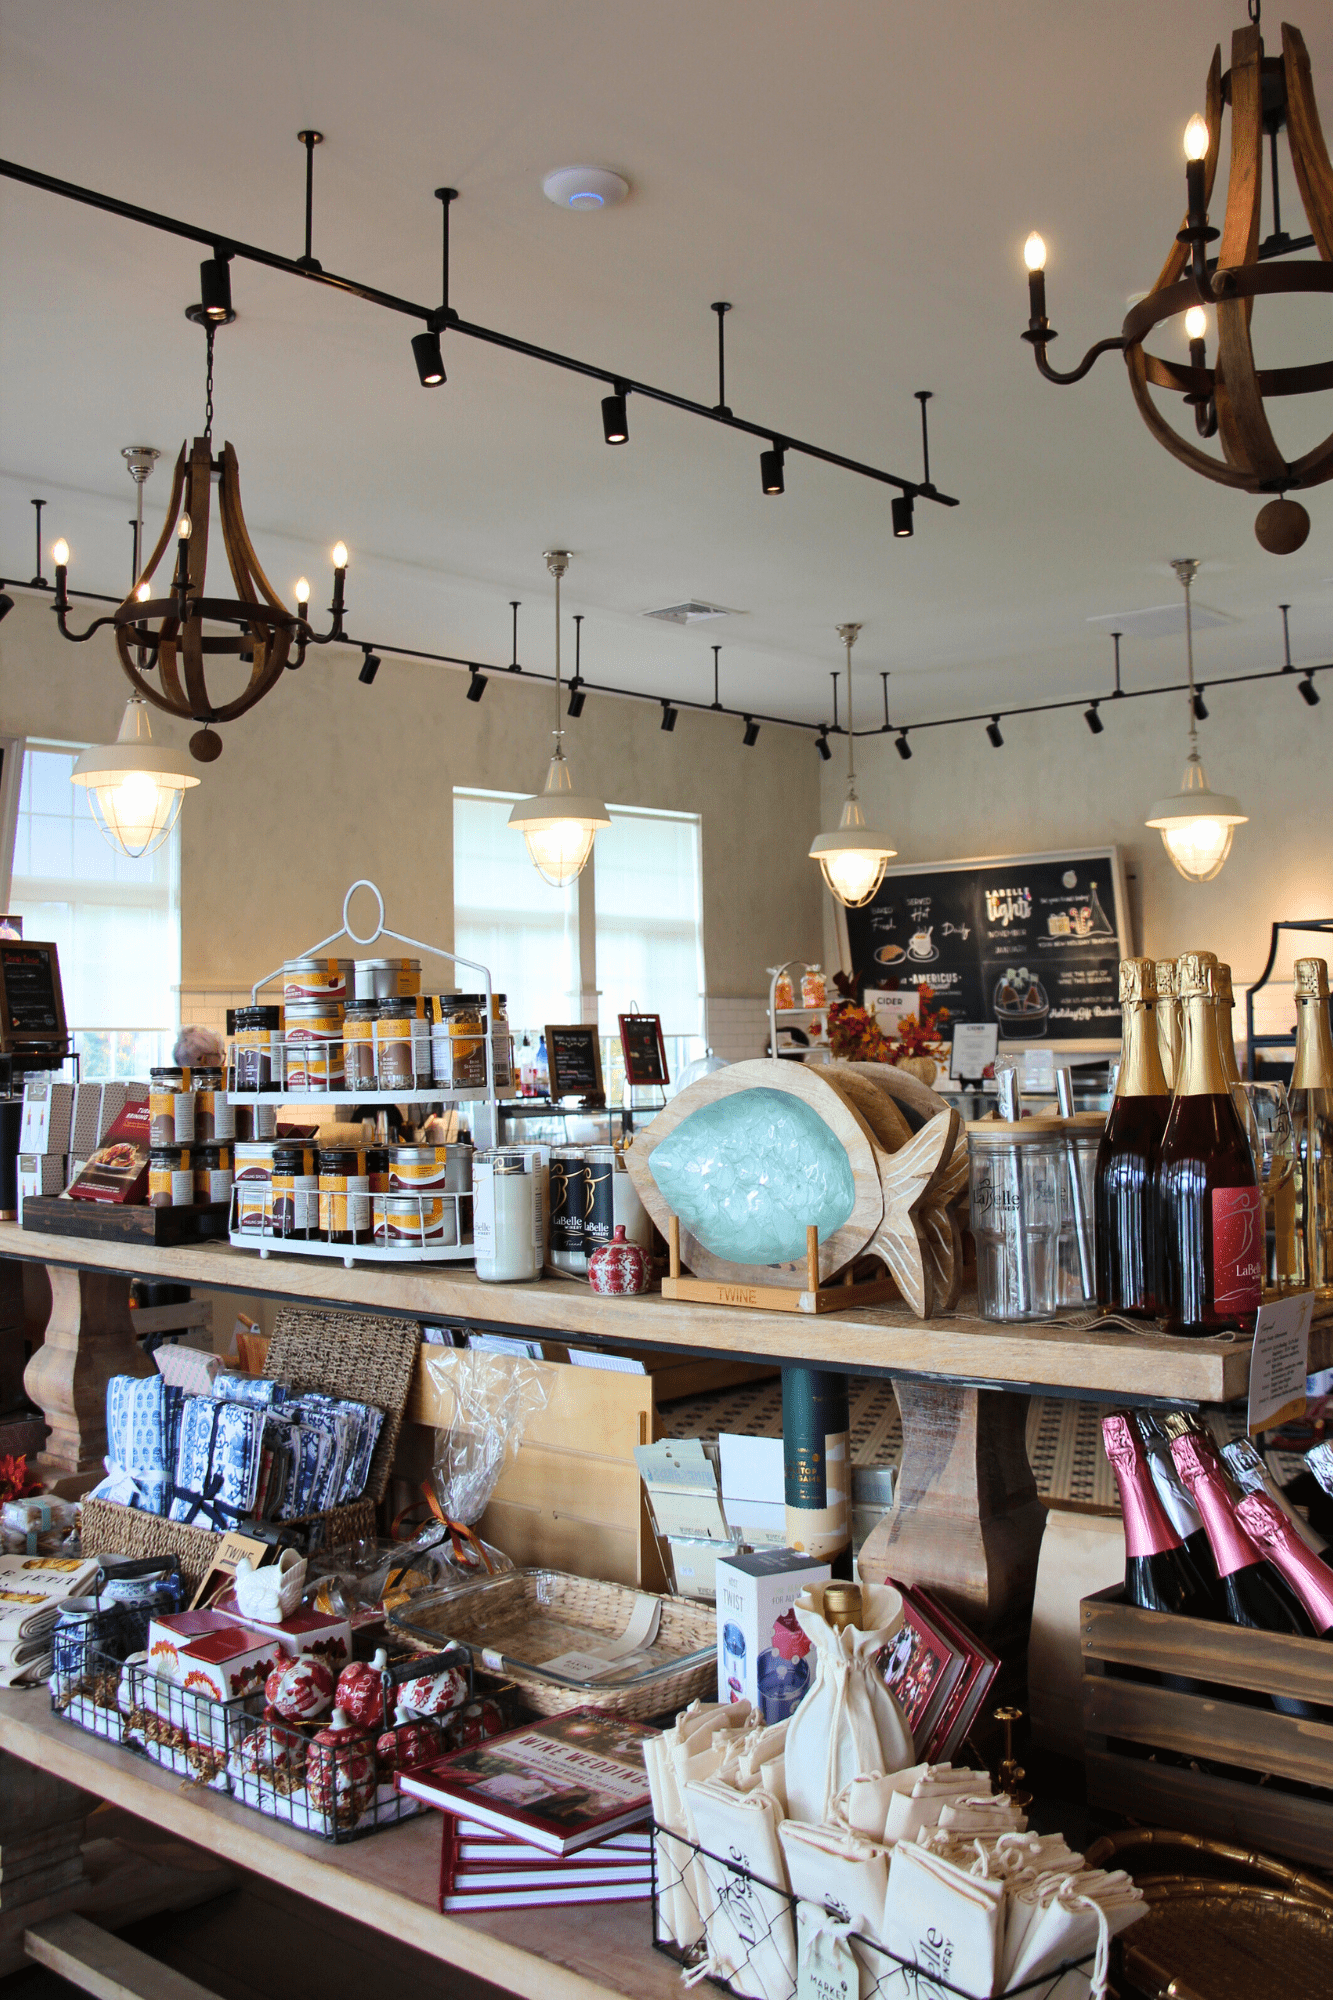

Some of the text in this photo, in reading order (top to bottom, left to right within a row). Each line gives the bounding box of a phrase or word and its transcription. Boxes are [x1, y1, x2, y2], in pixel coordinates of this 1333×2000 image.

[986, 897, 1032, 927] lights
[987, 929, 1027, 938] NOVEMBER
[911, 973, 958, 984] AMERICUS
[877, 997, 903, 1006] CIDER
[553, 1216, 583, 1226] LaBelle
[584, 1221, 609, 1232] LaBelle
[717, 1286, 757, 1304] TWINE
[224, 1544, 254, 1561] TWINE
[723, 1588, 743, 1612] TWIST
[772, 1595, 784, 1605] FOR
[518, 1736, 569, 1757] WINE
[810, 1972, 846, 2000] MARKET
